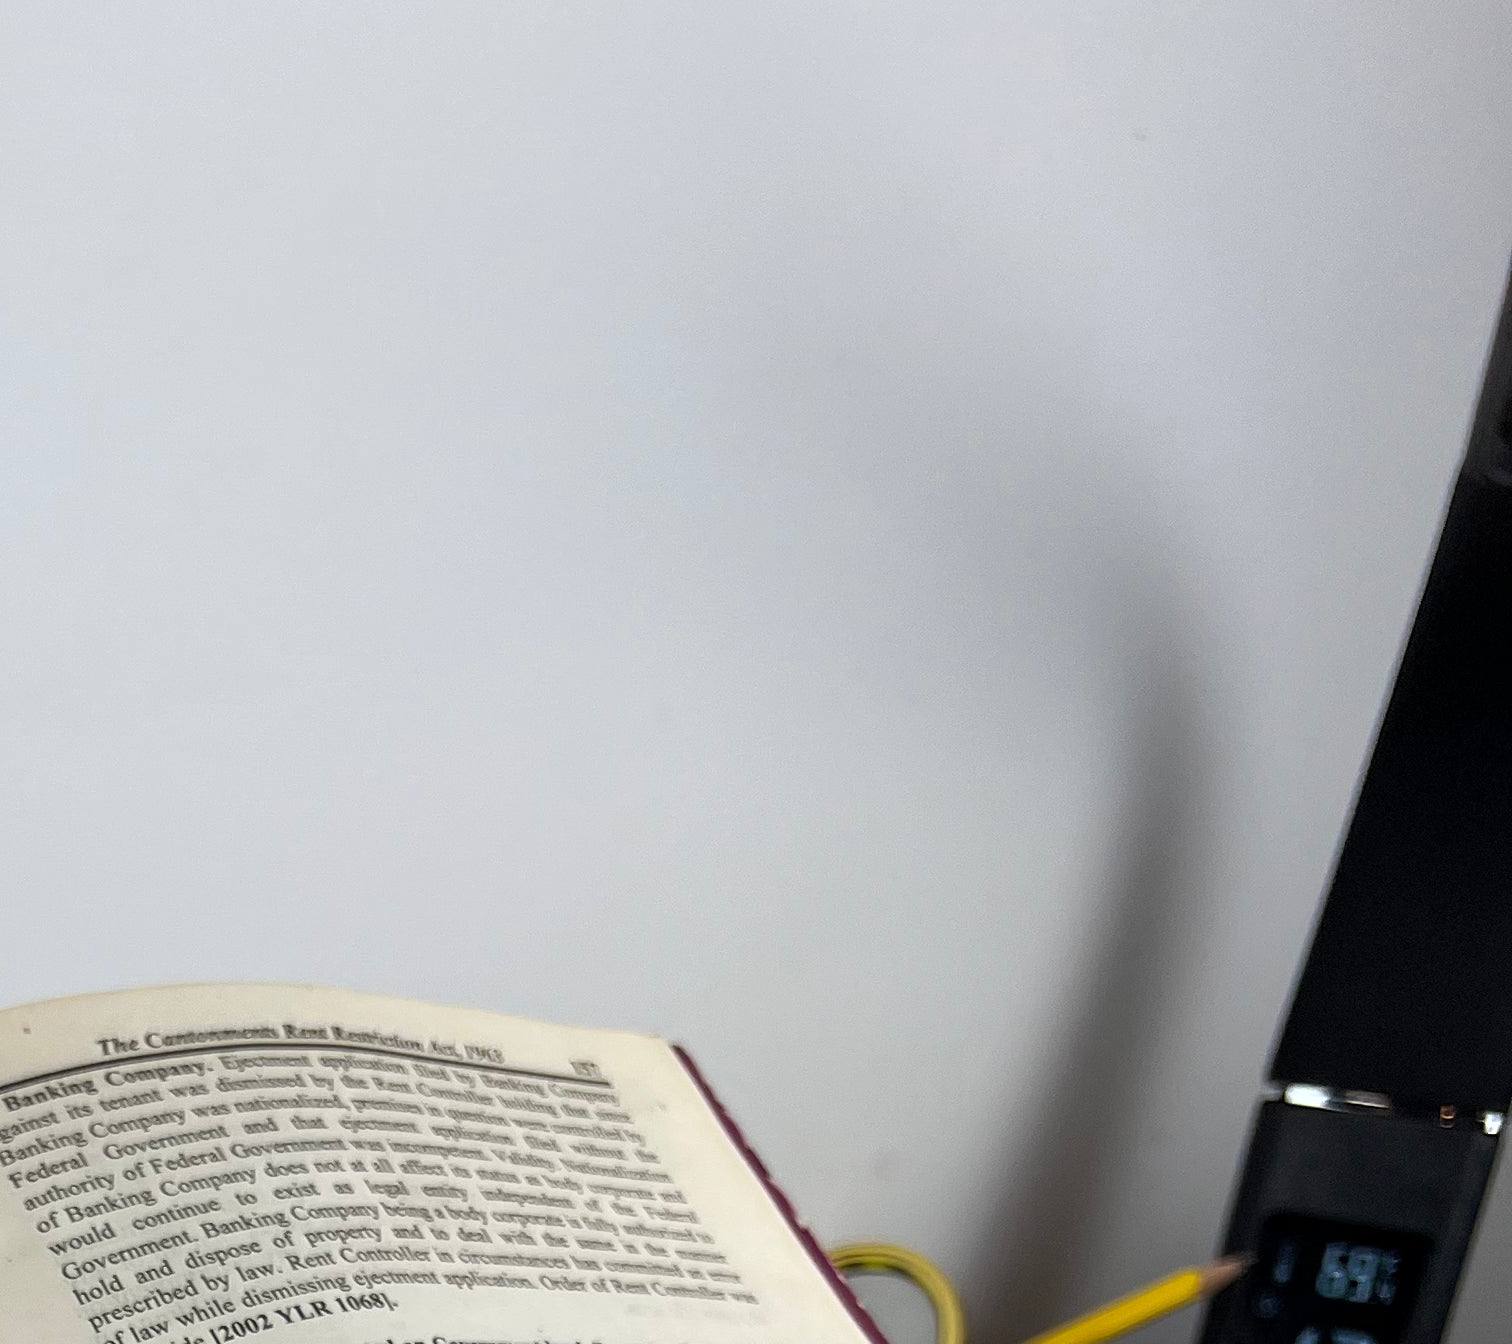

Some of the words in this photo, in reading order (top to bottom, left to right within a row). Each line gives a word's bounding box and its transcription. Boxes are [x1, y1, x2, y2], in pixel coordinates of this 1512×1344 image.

[2, 1080, 98, 1112] Banking
[104, 1062, 213, 1086] Company.
[274, 1301, 333, 1323] YLR
[335, 1293, 398, 1312] 1068].
